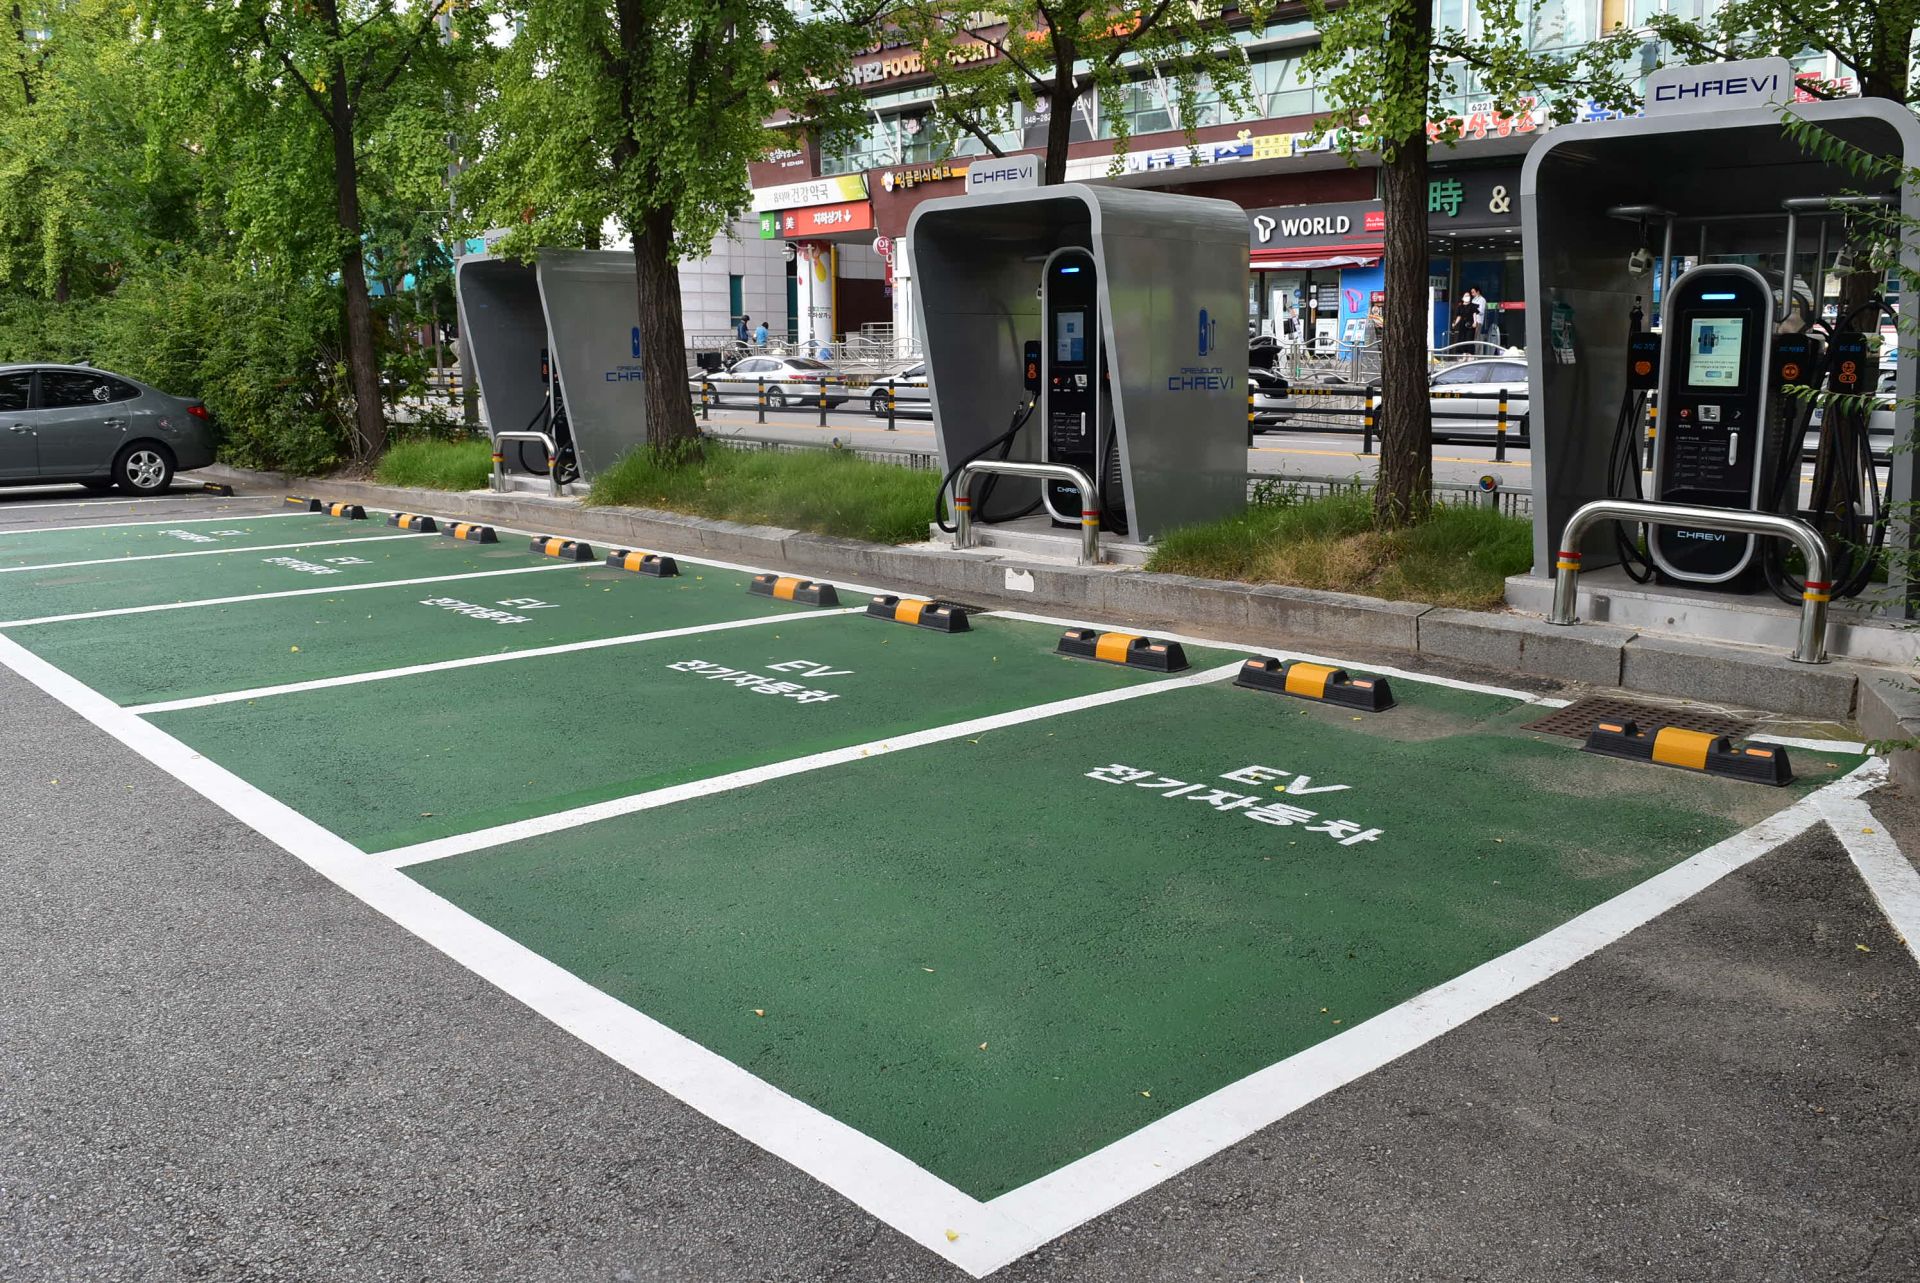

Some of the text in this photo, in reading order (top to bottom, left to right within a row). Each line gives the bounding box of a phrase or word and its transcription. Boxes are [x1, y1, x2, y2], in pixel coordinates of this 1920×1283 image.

[1655, 74, 1778, 102] CHAEVI
[1024, 113, 1051, 125] 948-282
[972, 166, 1033, 185] CHAEVI
[791, 184, 829, 203] 건강약국
[1489, 185, 1511, 214] &
[813, 210, 842, 225] 지하상가
[1281, 215, 1351, 237] WORLD
[878, 239, 890, 254] 약
[606, 371, 645, 382] CHA
[1168, 376, 1234, 391] CHAEVI
[1056, 486, 1080, 495] CHAEV
[1677, 530, 1726, 543] CHAEVI
[496, 598, 560, 609] EV
[765, 659, 855, 677] EV
[666, 659, 840, 704] 전기자동차
[1218, 765, 1352, 795] EV
[1084, 763, 1385, 846] 전기자동차
